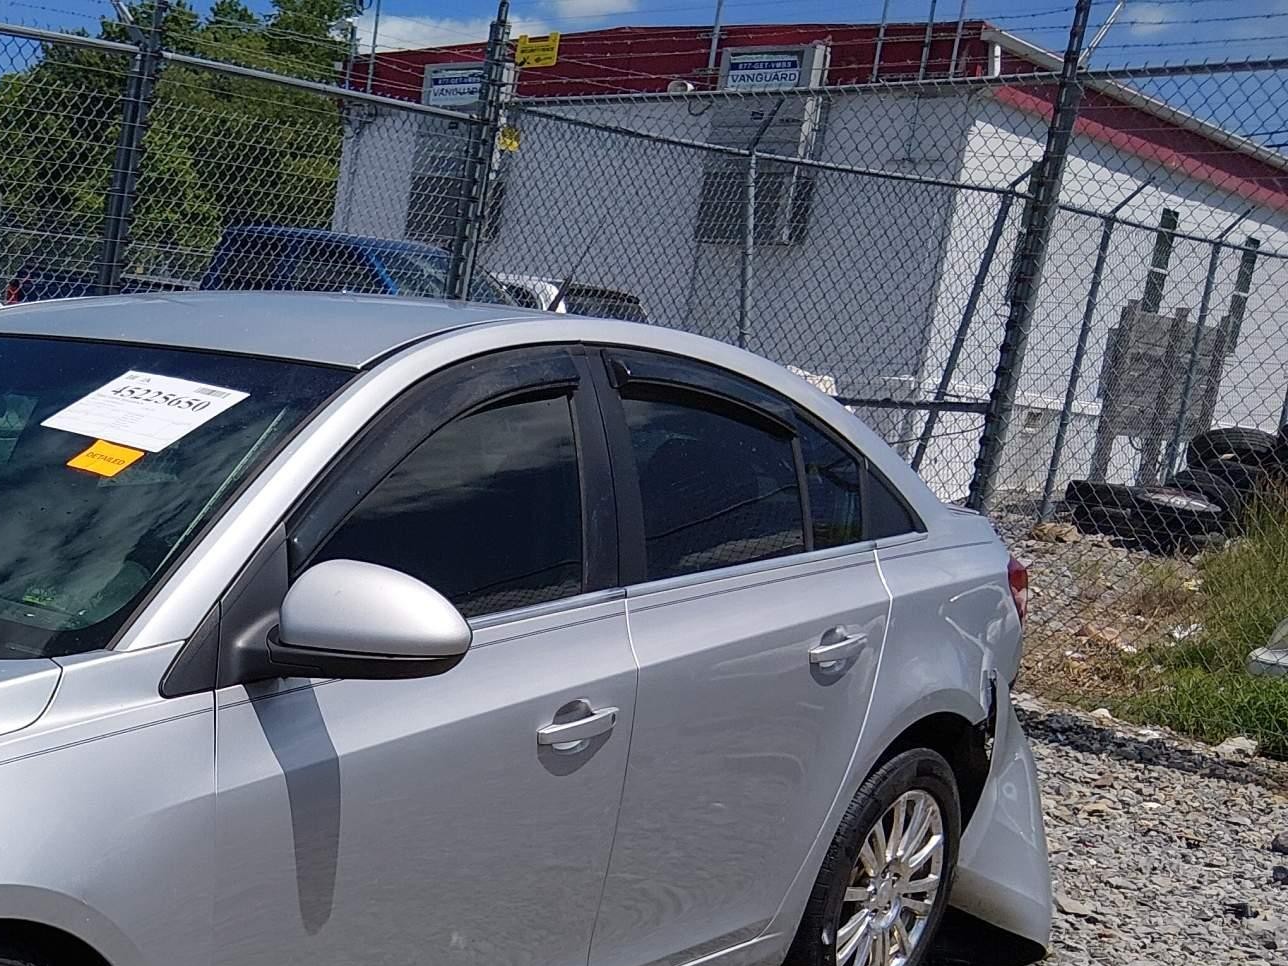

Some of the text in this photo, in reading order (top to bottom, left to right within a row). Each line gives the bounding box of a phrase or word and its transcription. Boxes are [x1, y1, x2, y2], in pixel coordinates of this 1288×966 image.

[731, 72, 797, 83] VANGUARD
[111, 386, 211, 412] 45225650
[86, 451, 126, 466] DETAILED
